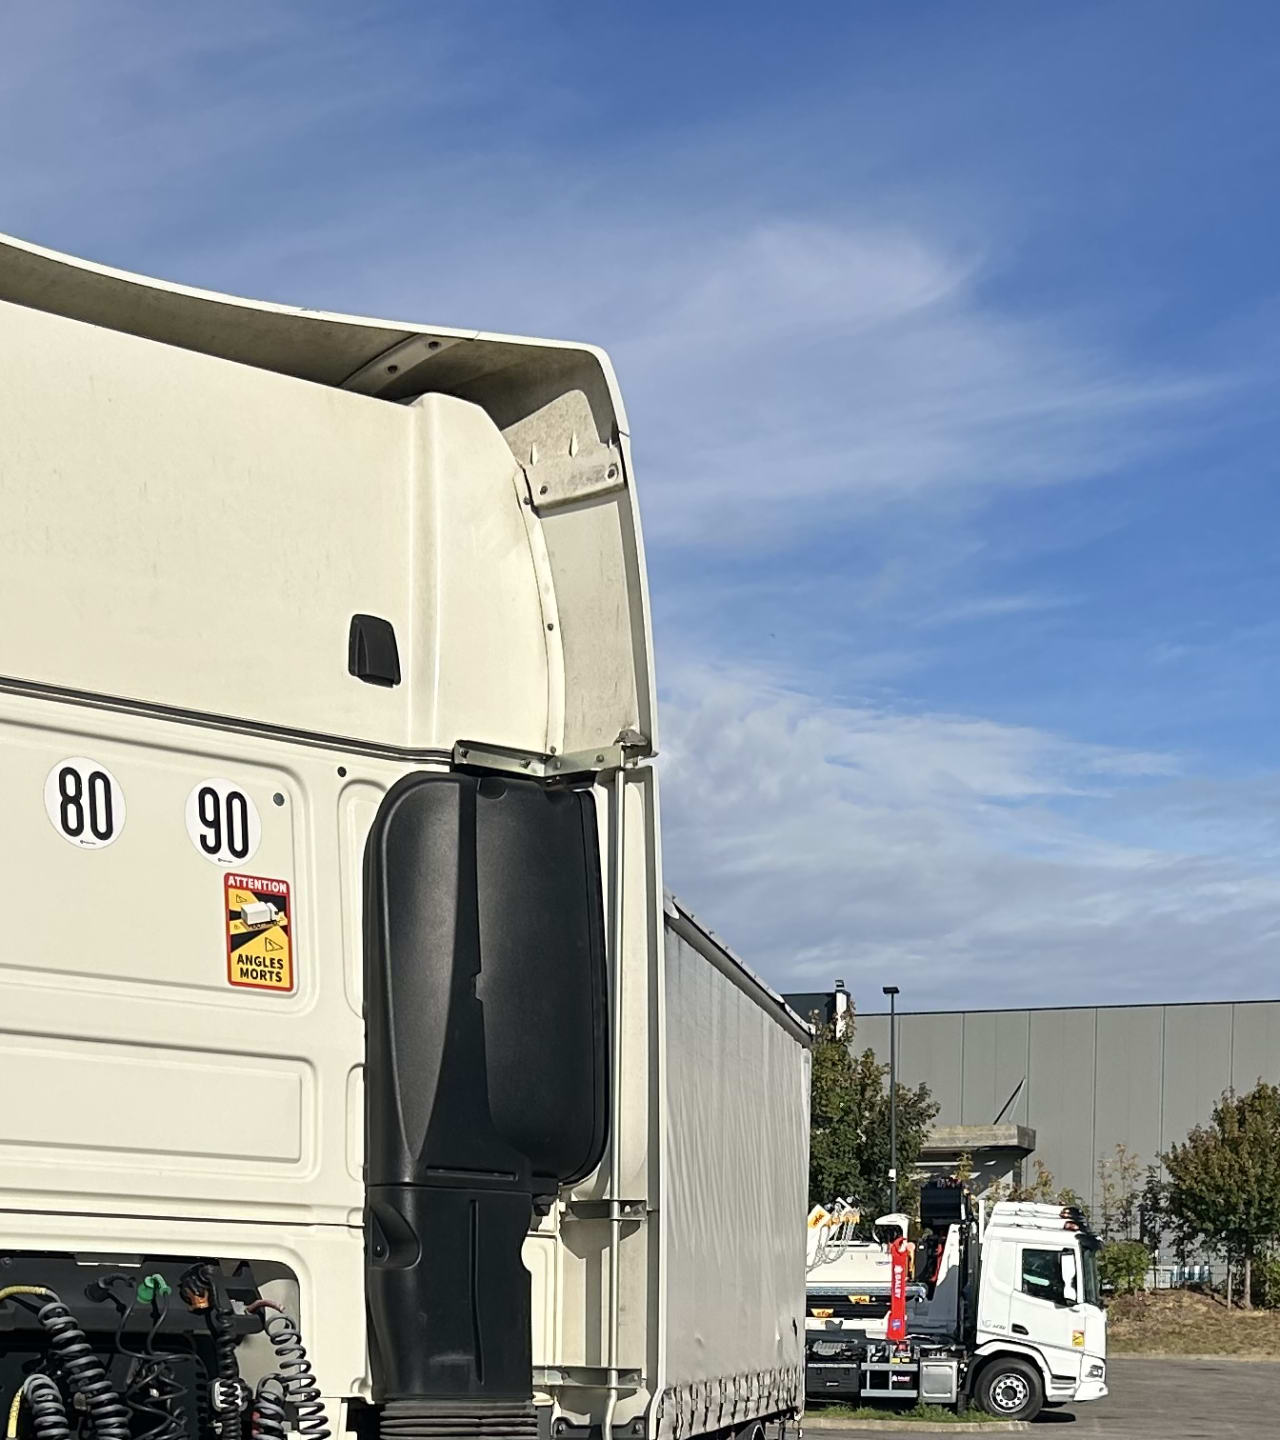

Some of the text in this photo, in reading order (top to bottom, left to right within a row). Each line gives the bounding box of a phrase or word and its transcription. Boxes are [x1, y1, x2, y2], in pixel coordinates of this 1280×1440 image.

[59, 767, 113, 840] 80
[198, 787, 249, 859] 90
[228, 876, 287, 893] ATTENTION
[237, 954, 283, 970] ANGLES
[240, 967, 282, 982] MORTS
